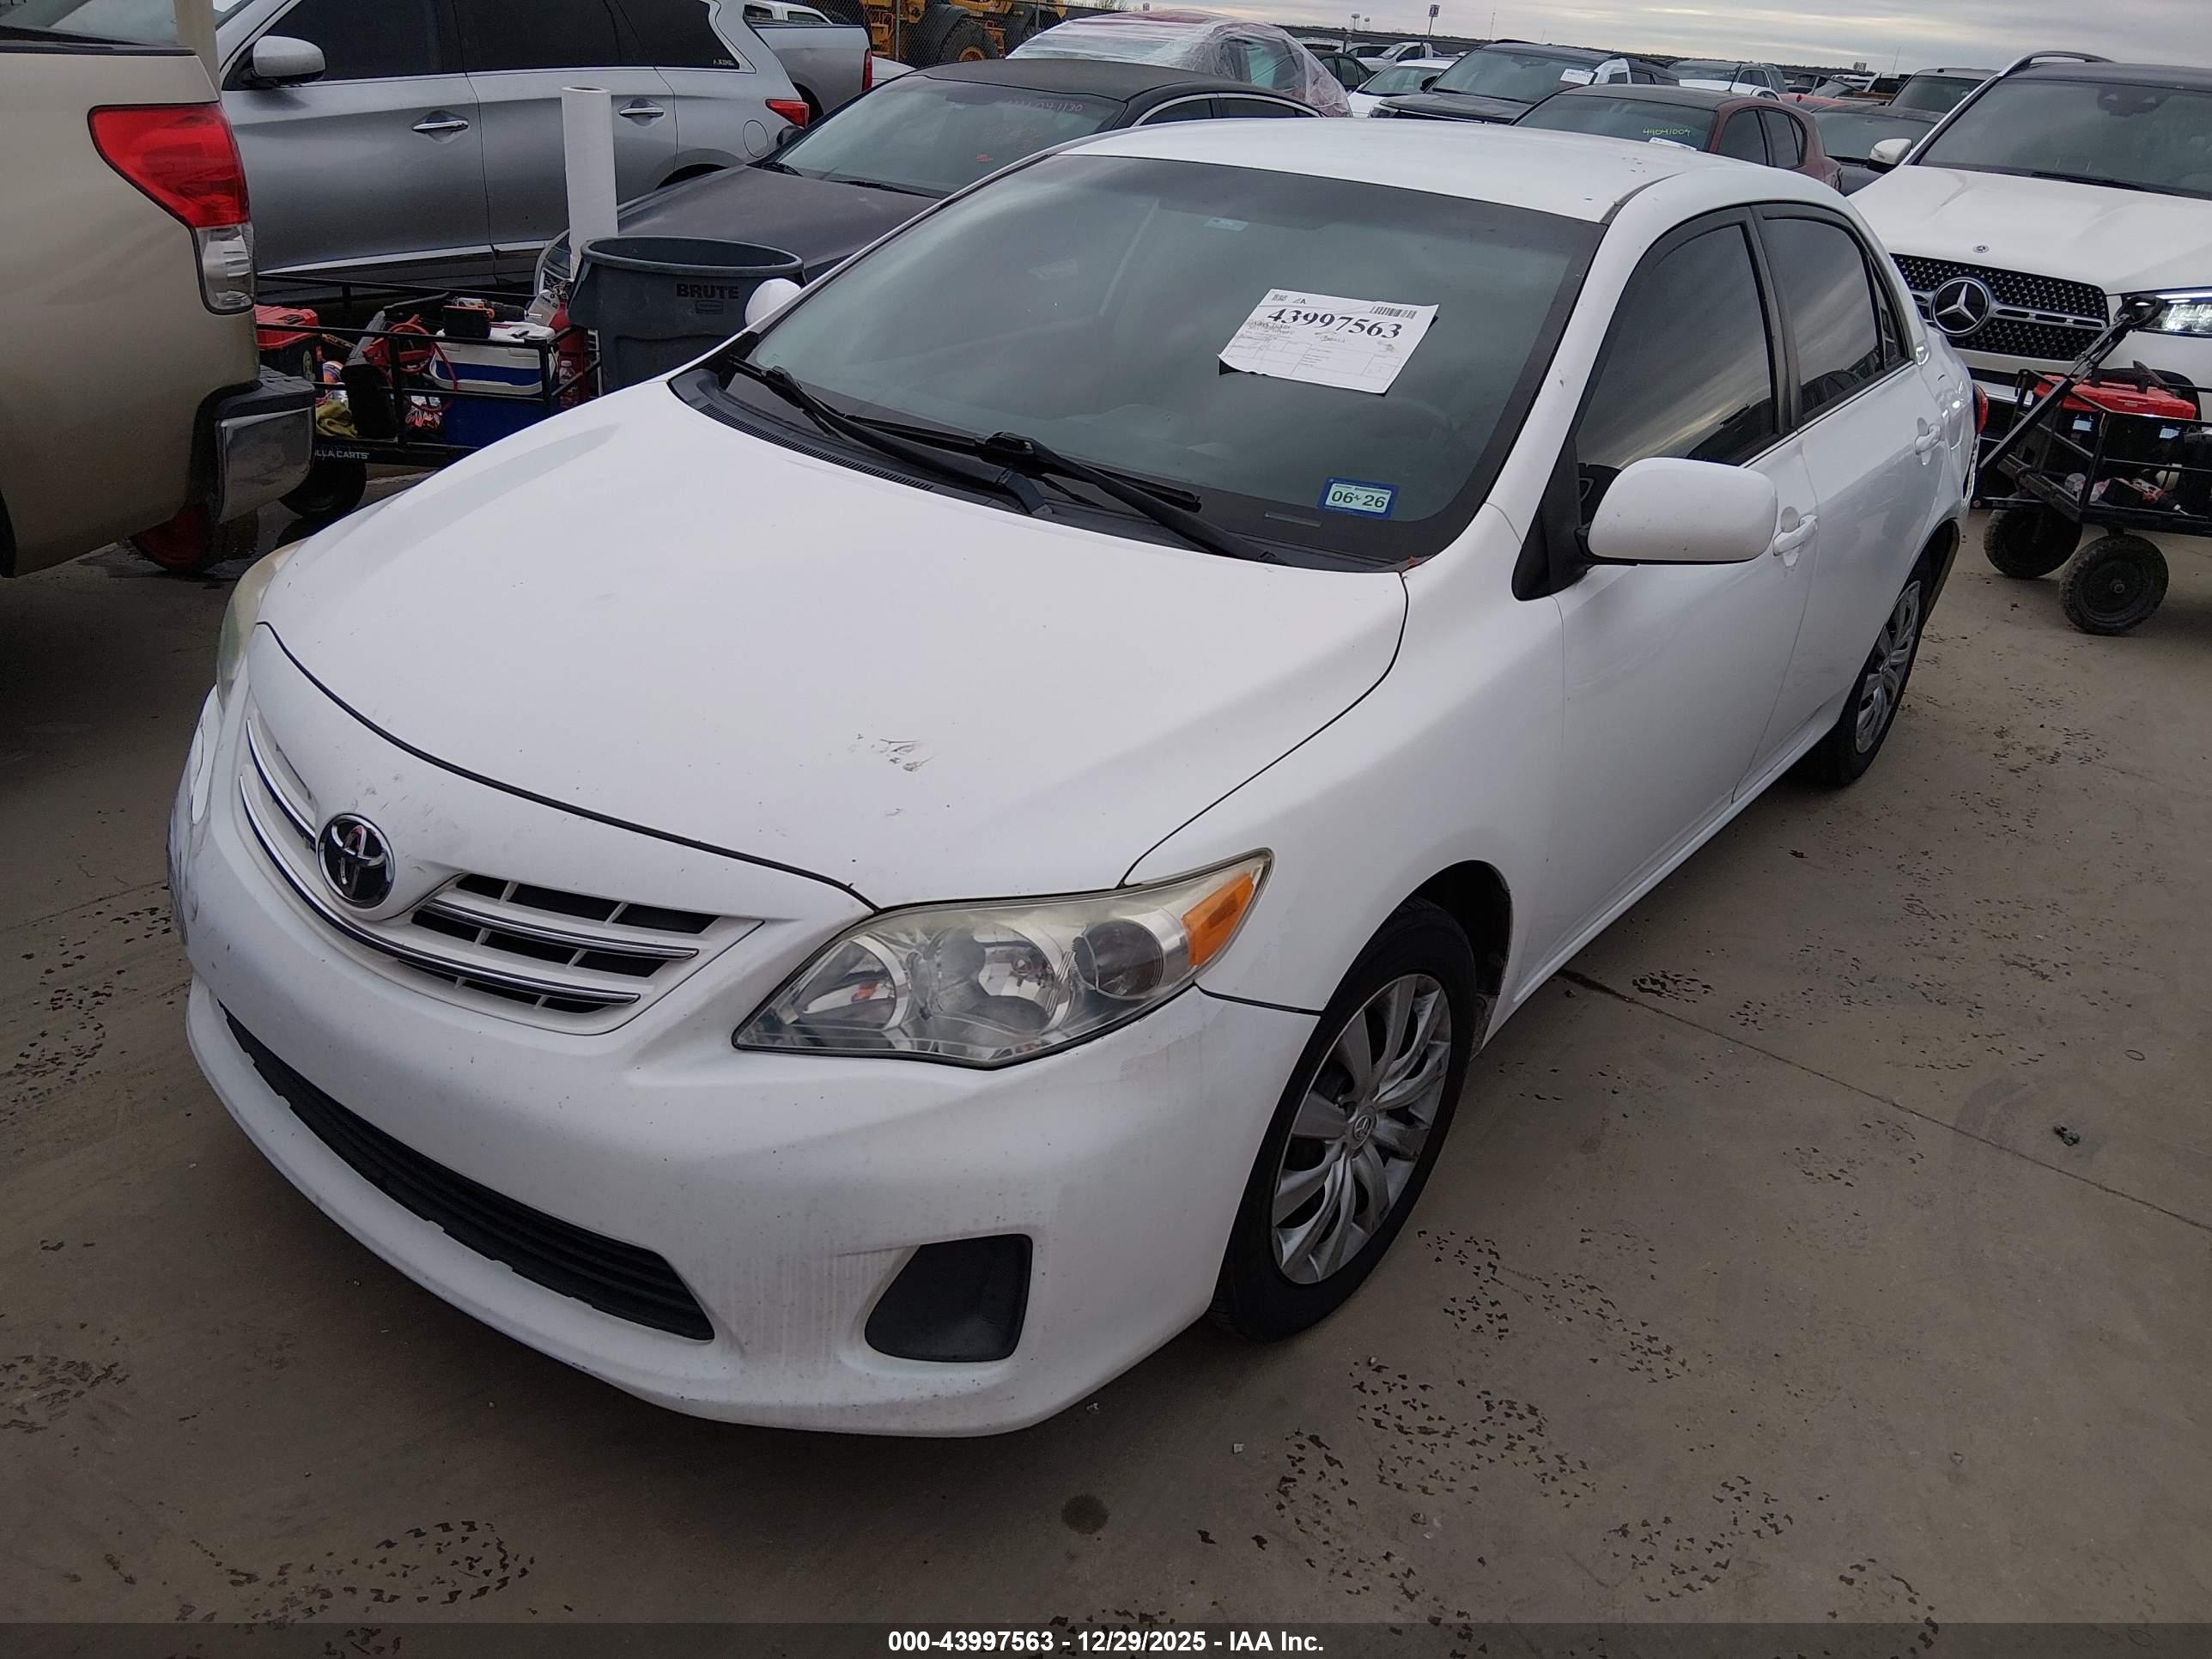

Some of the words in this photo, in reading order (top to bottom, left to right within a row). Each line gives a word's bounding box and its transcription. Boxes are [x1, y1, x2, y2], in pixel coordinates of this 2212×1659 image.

[676, 283, 739, 300] BRUTE
[1267, 307, 1403, 339] 43997563
[336, 450, 370, 459] CARTS
[1332, 490, 1355, 504] 06
[1362, 495, 1387, 508] 26
